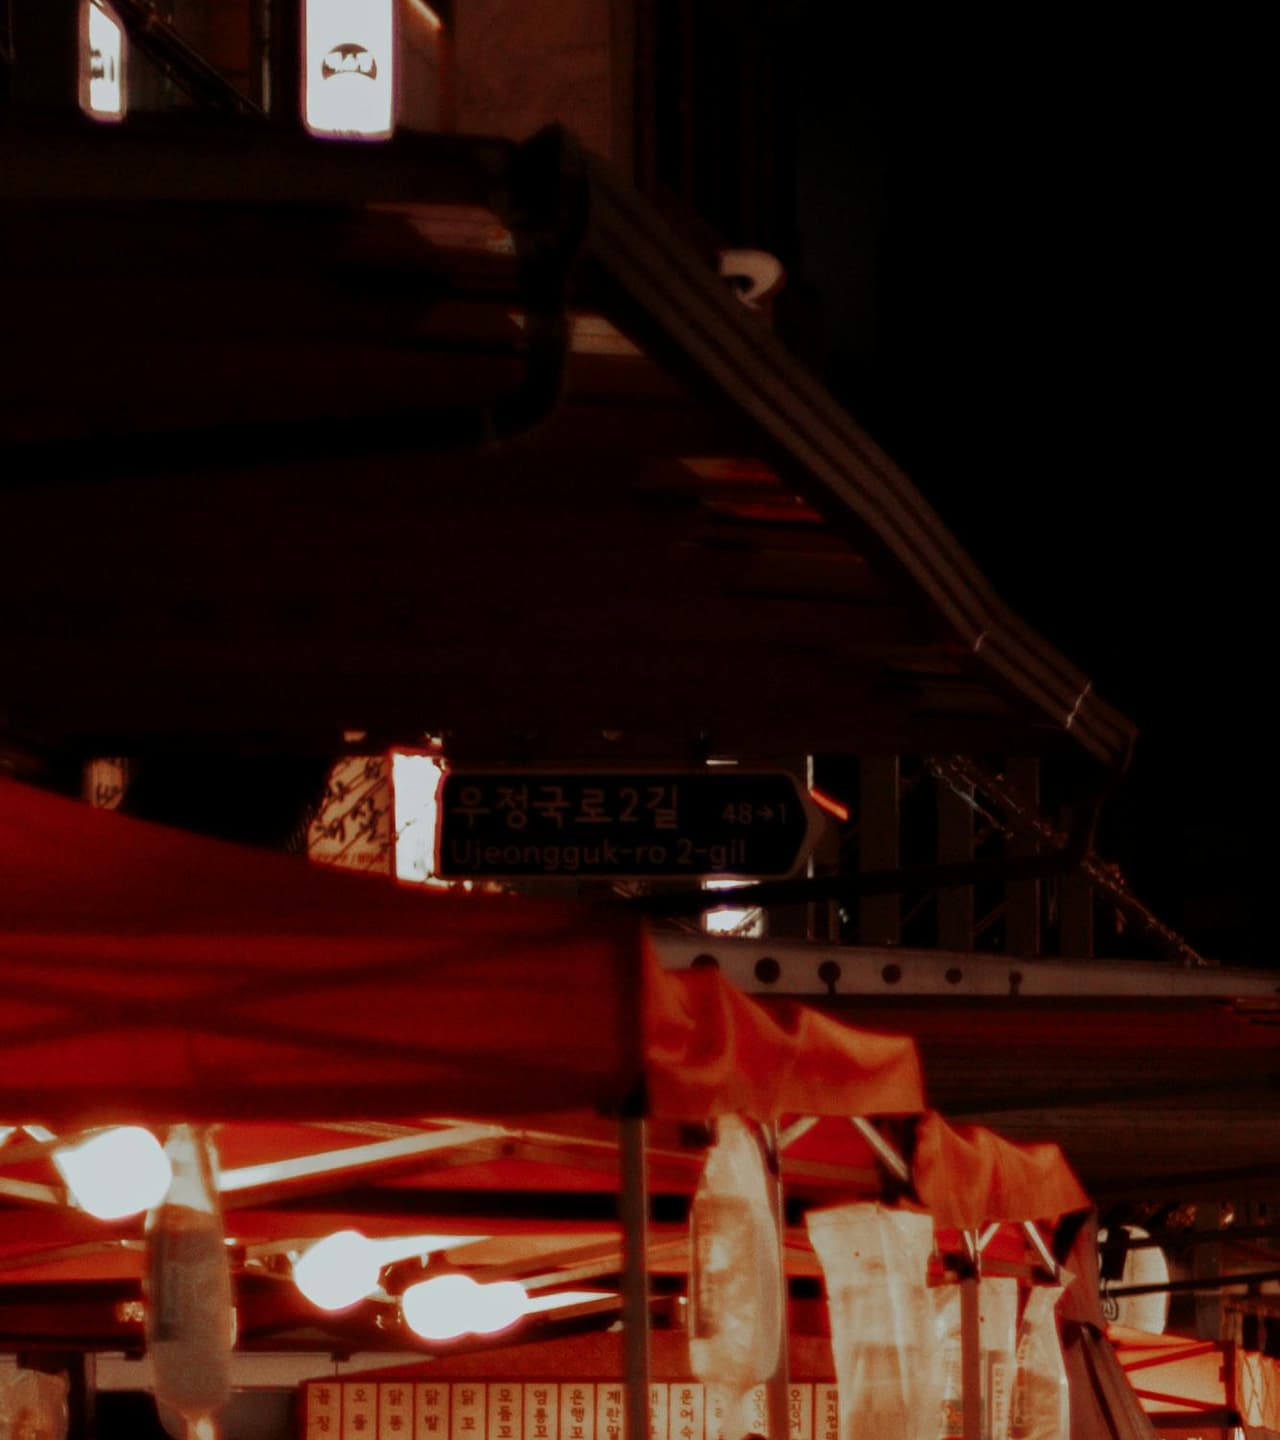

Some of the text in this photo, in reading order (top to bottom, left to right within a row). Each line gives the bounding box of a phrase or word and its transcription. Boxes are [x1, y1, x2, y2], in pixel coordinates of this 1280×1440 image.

[449, 785, 682, 831] 우정국로2길
[450, 838, 748, 869] Ujeongguk-ro 2-gil
